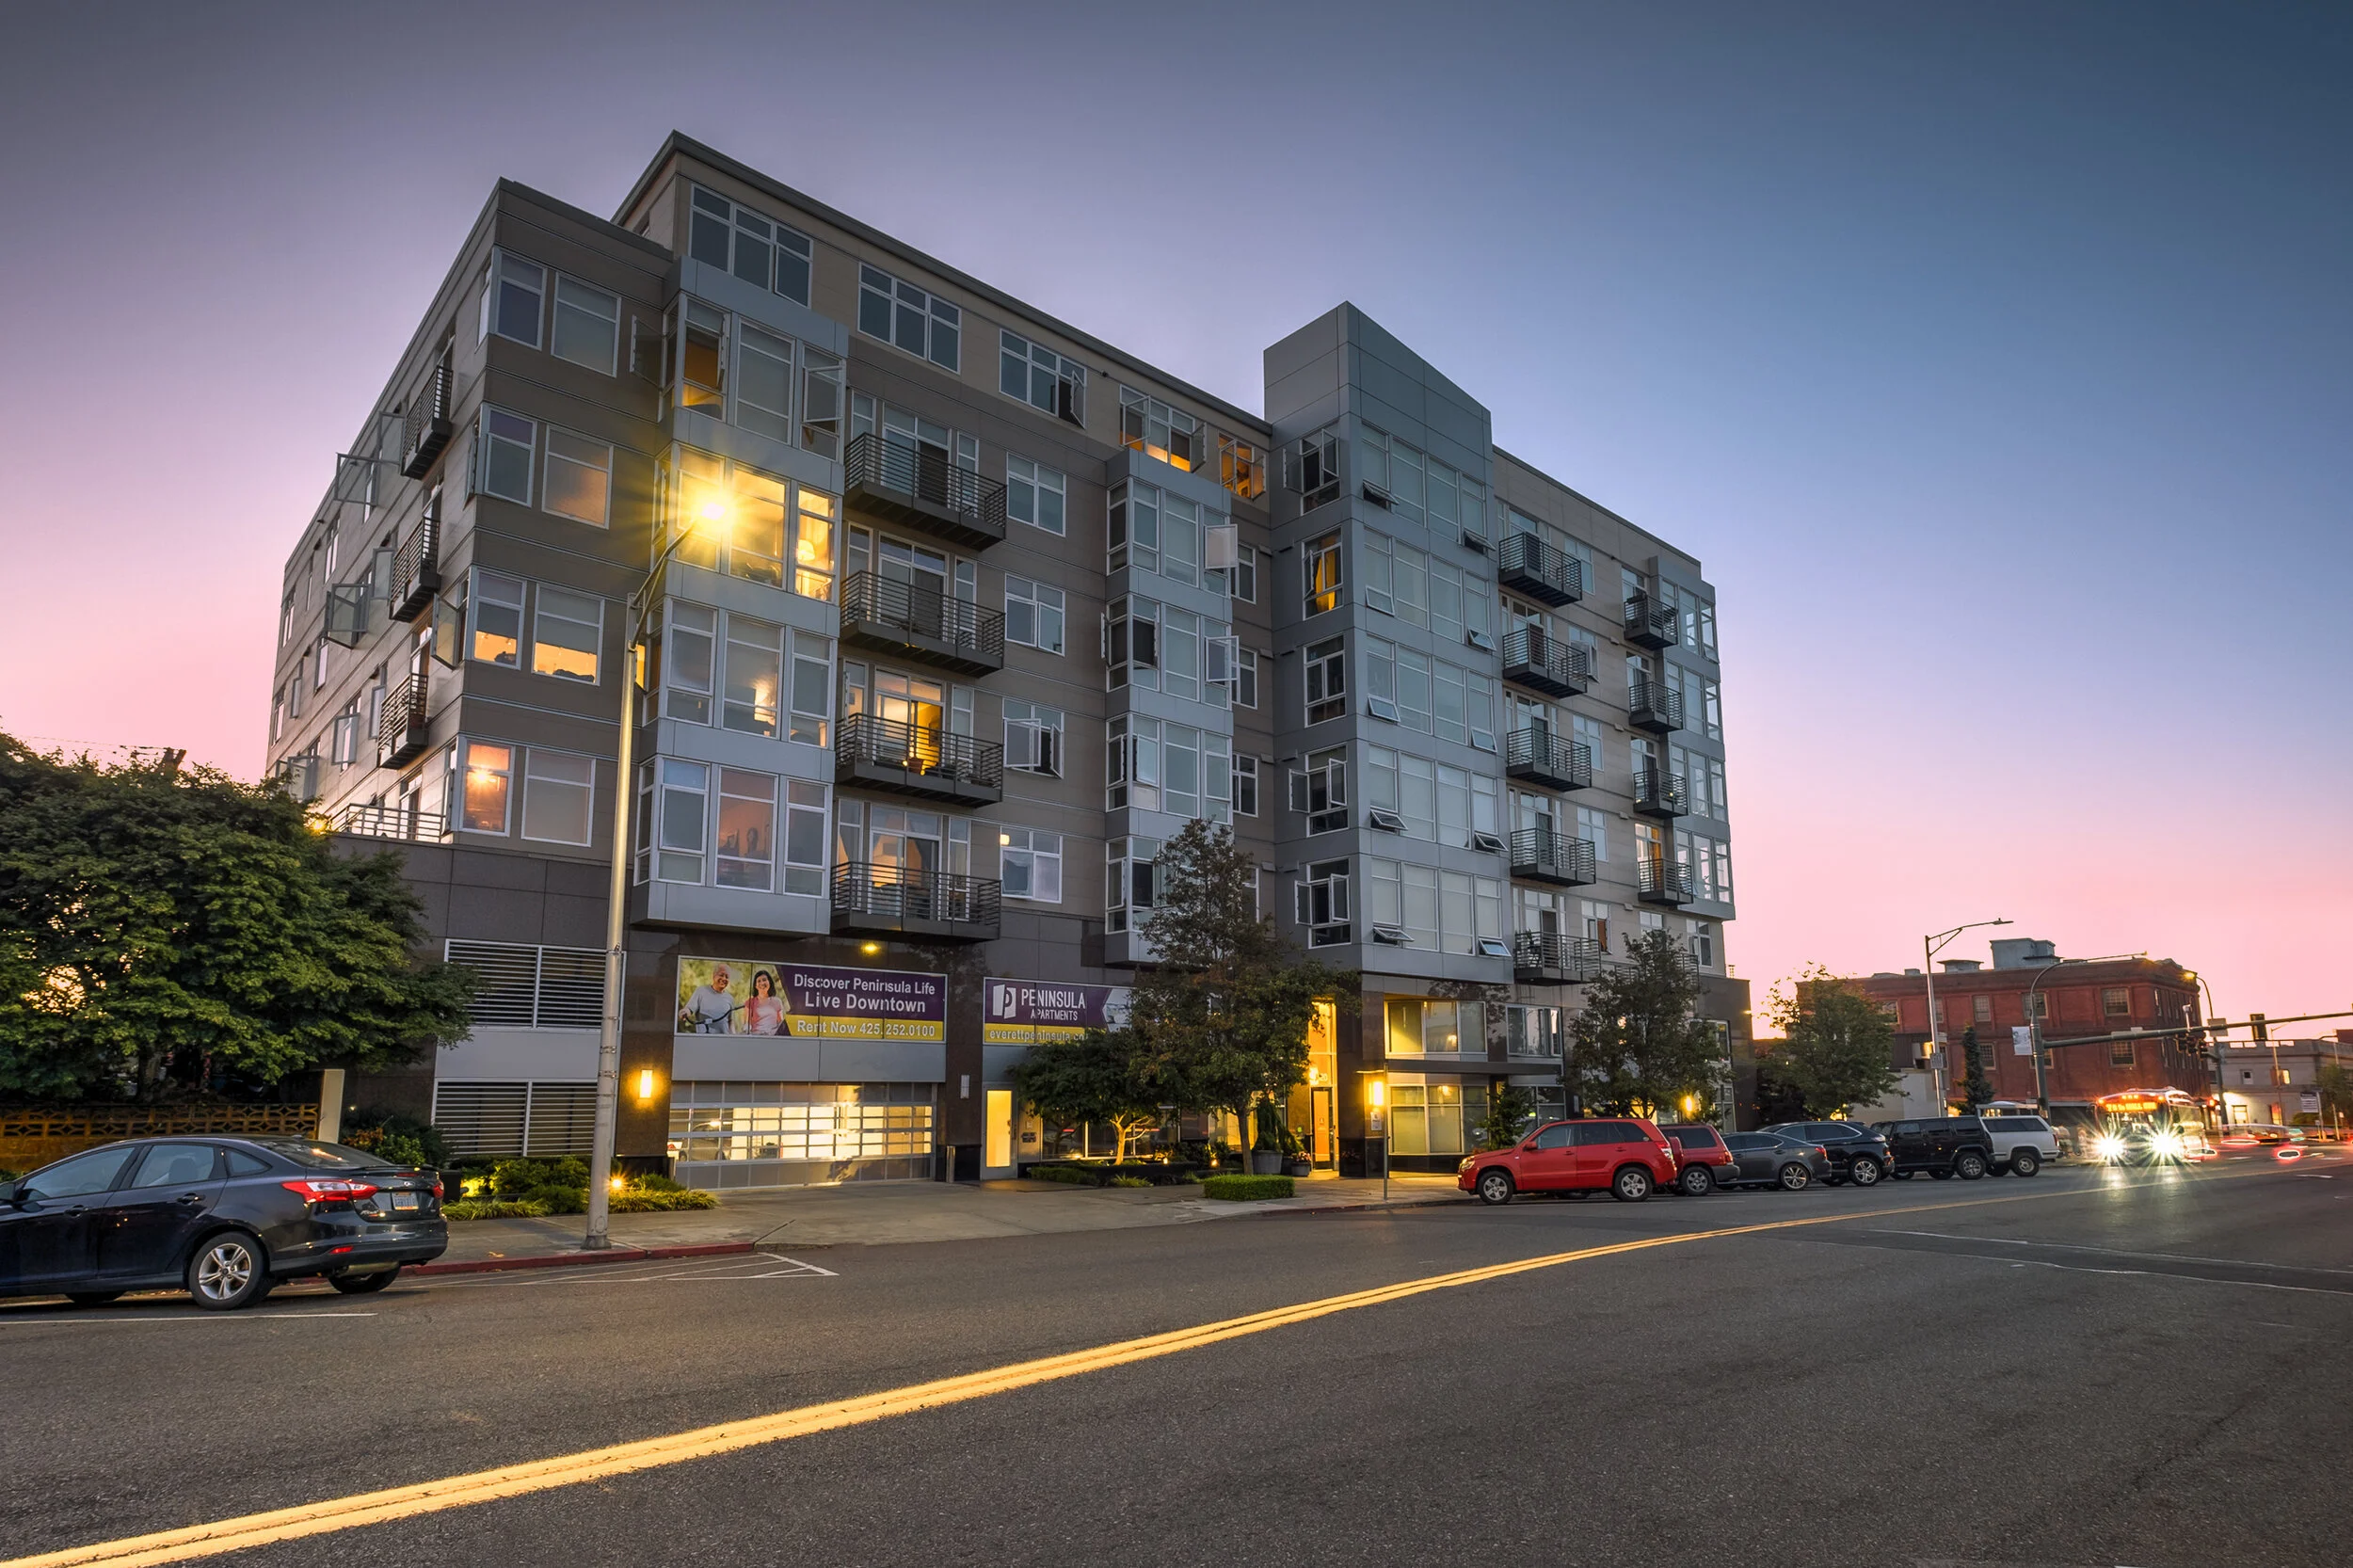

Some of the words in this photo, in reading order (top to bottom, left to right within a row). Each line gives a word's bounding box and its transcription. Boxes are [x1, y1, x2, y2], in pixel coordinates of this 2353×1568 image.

[794, 973, 850, 990] Discover
[853, 977, 911, 994] Peninsula
[914, 982, 936, 995] Life
[805, 991, 840, 1008] Live
[846, 993, 926, 1013] Downtown
[1021, 988, 1086, 1009] PENINSULA
[1030, 1008, 1079, 1021] APARTMENTS
[796, 1019, 826, 1033] Rent
[830, 1021, 856, 1034] Now
